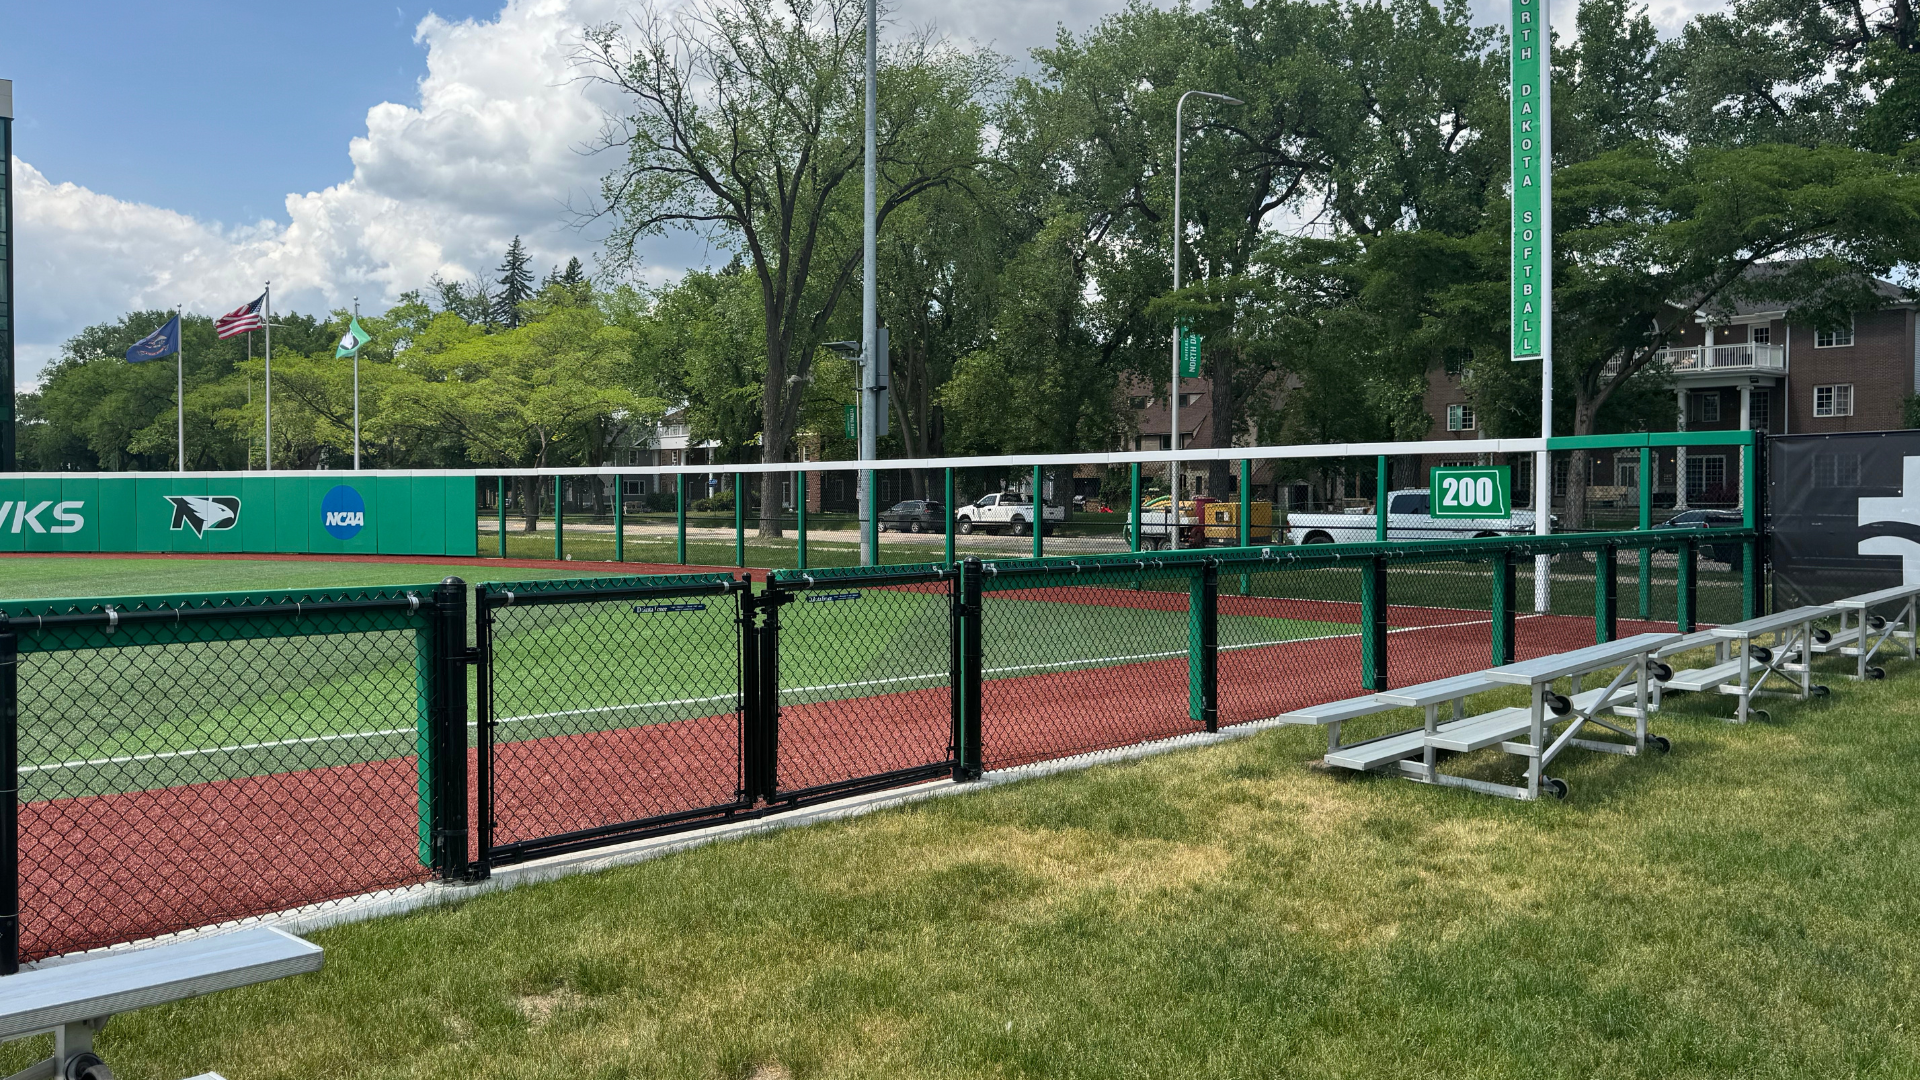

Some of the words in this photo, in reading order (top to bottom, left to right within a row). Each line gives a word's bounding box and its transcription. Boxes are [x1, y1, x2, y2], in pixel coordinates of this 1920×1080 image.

[1521, 84, 1532, 187] DAKOTA
[1522, 211, 1533, 350] SOFTBALL
[1188, 346, 1197, 373] NORTH
[1442, 477, 1493, 507] 200
[325, 511, 364, 526] NCAA
